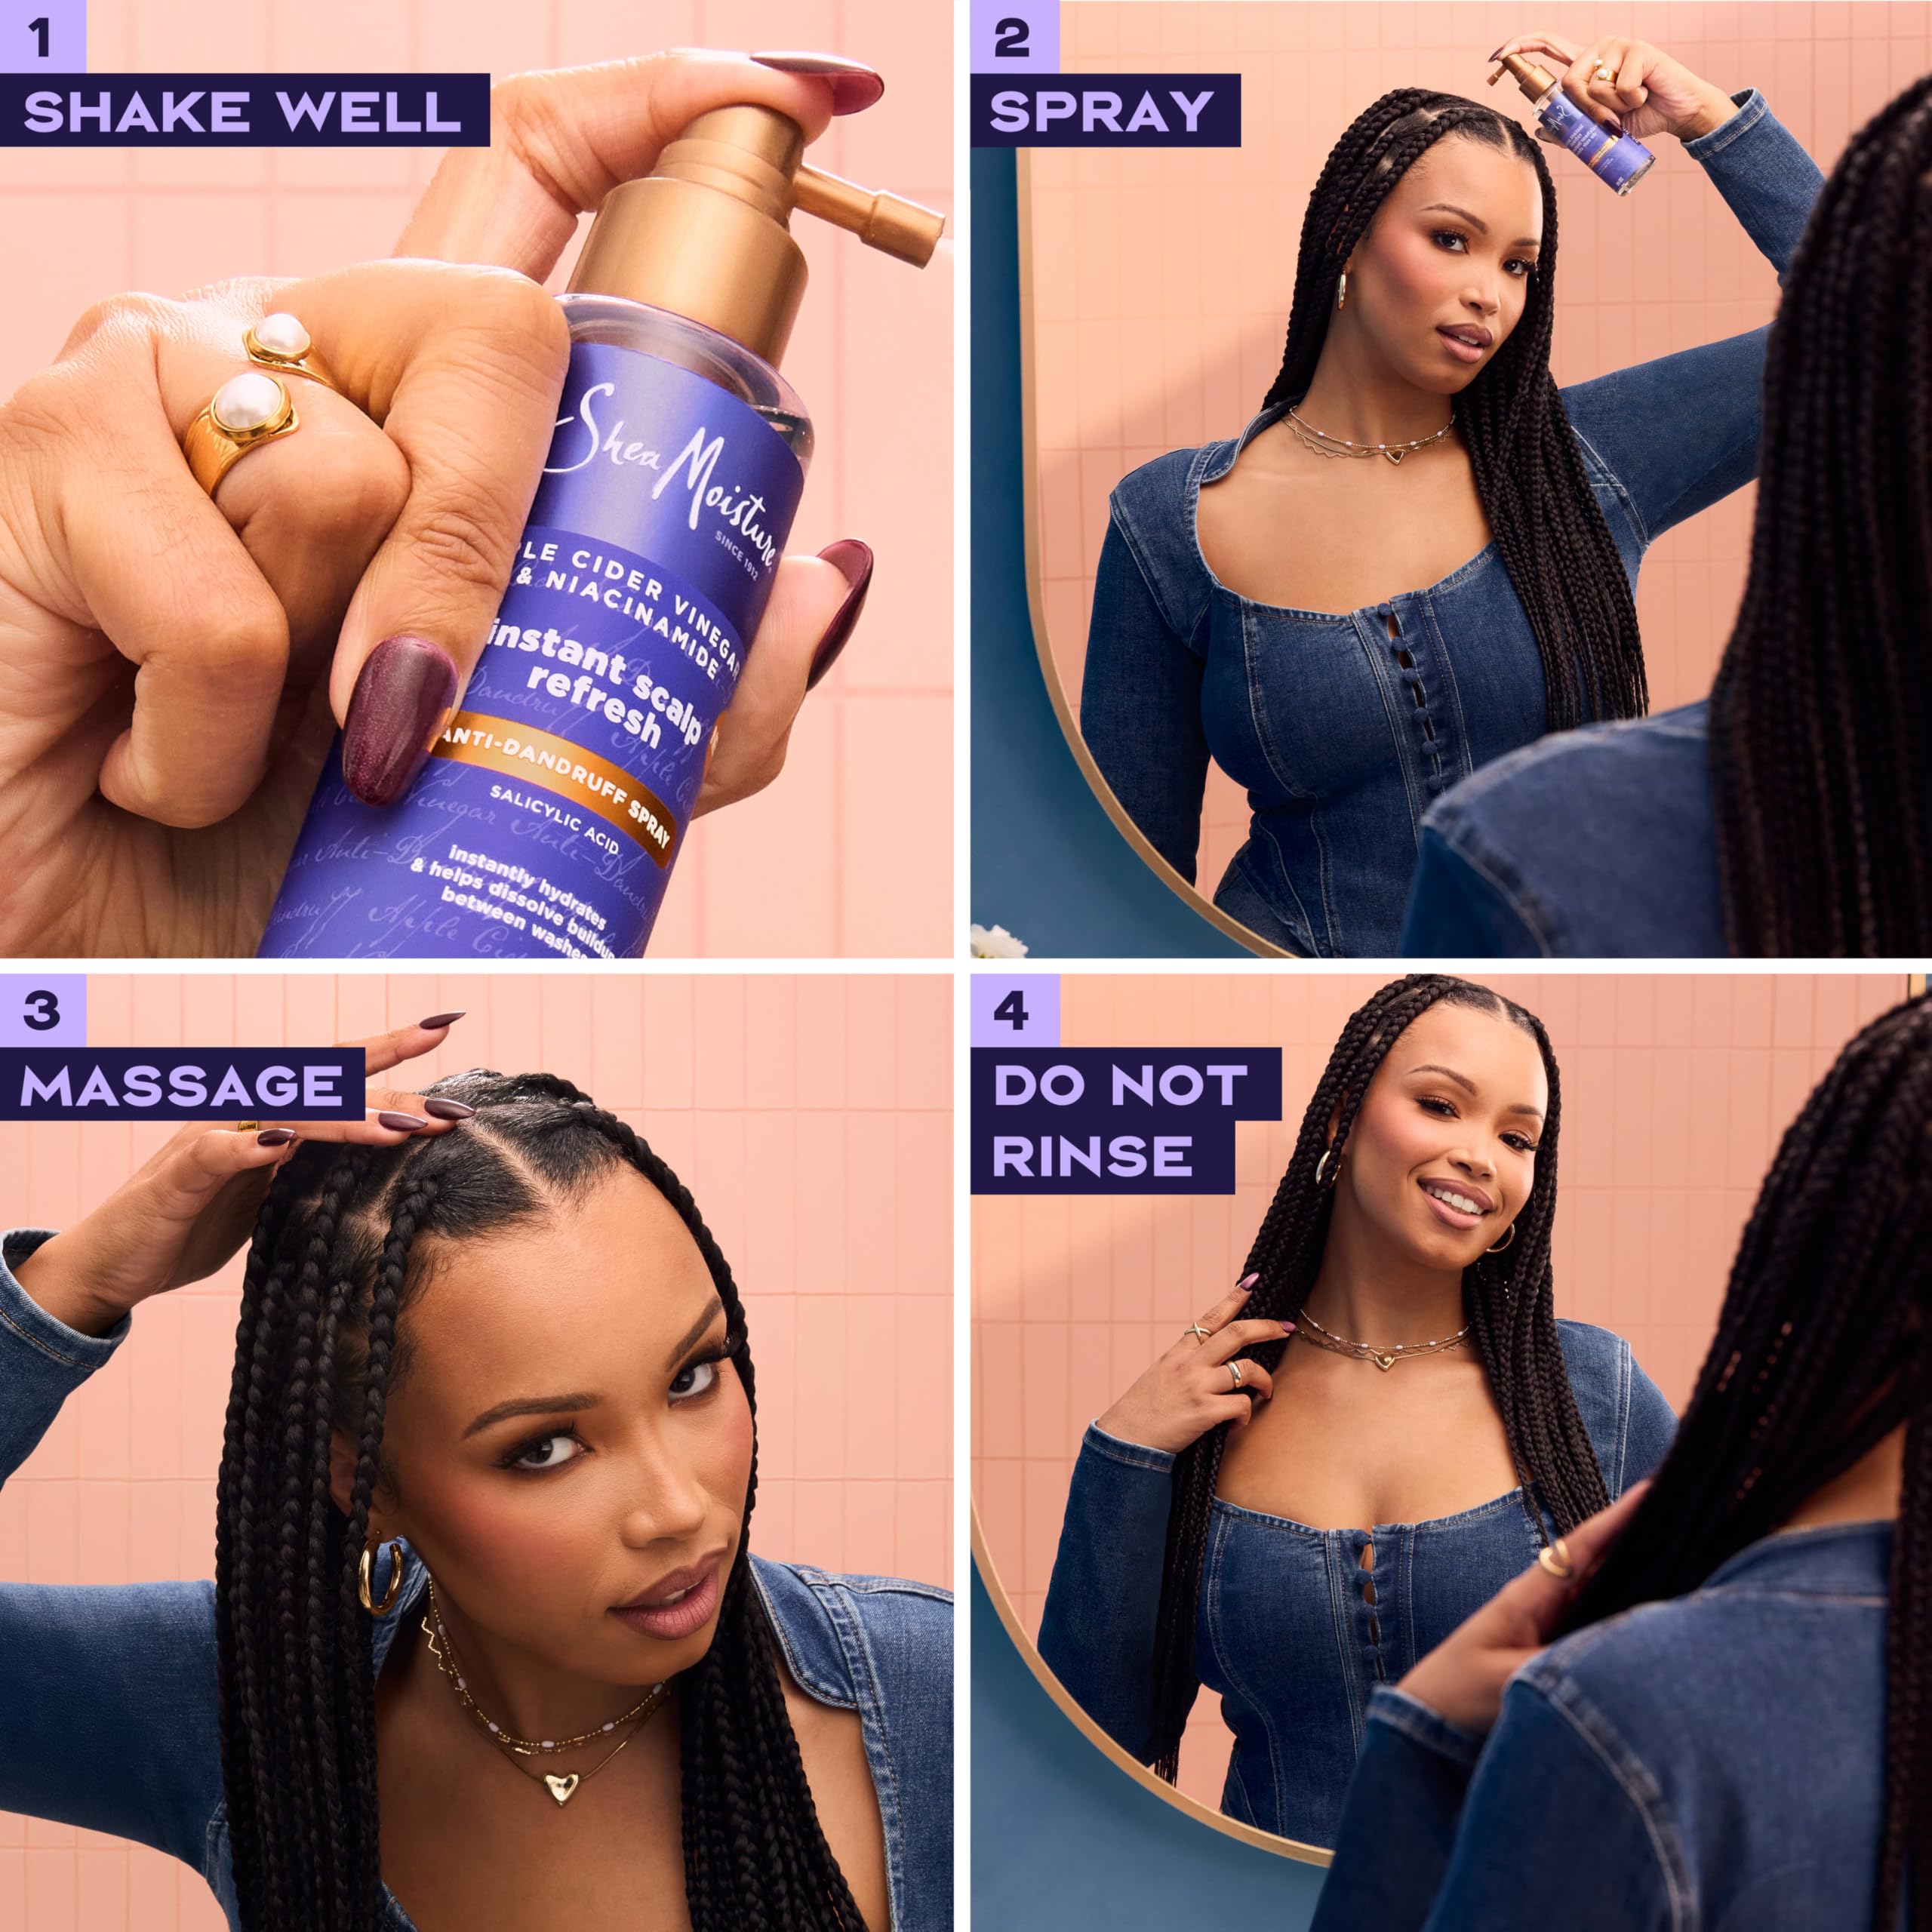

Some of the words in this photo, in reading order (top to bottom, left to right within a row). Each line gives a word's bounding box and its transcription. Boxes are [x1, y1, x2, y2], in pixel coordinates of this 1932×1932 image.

[714, 530, 744, 562] SINCE
[743, 558, 759, 582] 1912
[516, 566, 533, 586] &
[545, 570, 720, 681] NIACINAMIDE
[571, 549, 663, 602] CIDER
[675, 594, 741, 681] VINEGAR
[487, 617, 627, 685] instant
[632, 674, 703, 746] scalp
[526, 665, 662, 750] refresh
[489, 784, 582, 832] SALICYLIC
[583, 826, 620, 855] ACID
[627, 799, 670, 850] SPRAY
[410, 857, 424, 873] &
[429, 860, 484, 890] helps
[488, 881, 565, 926] dissolve
[441, 885, 527, 931] between
[448, 844, 536, 889] instantly
[537, 878, 607, 931] hydrates
